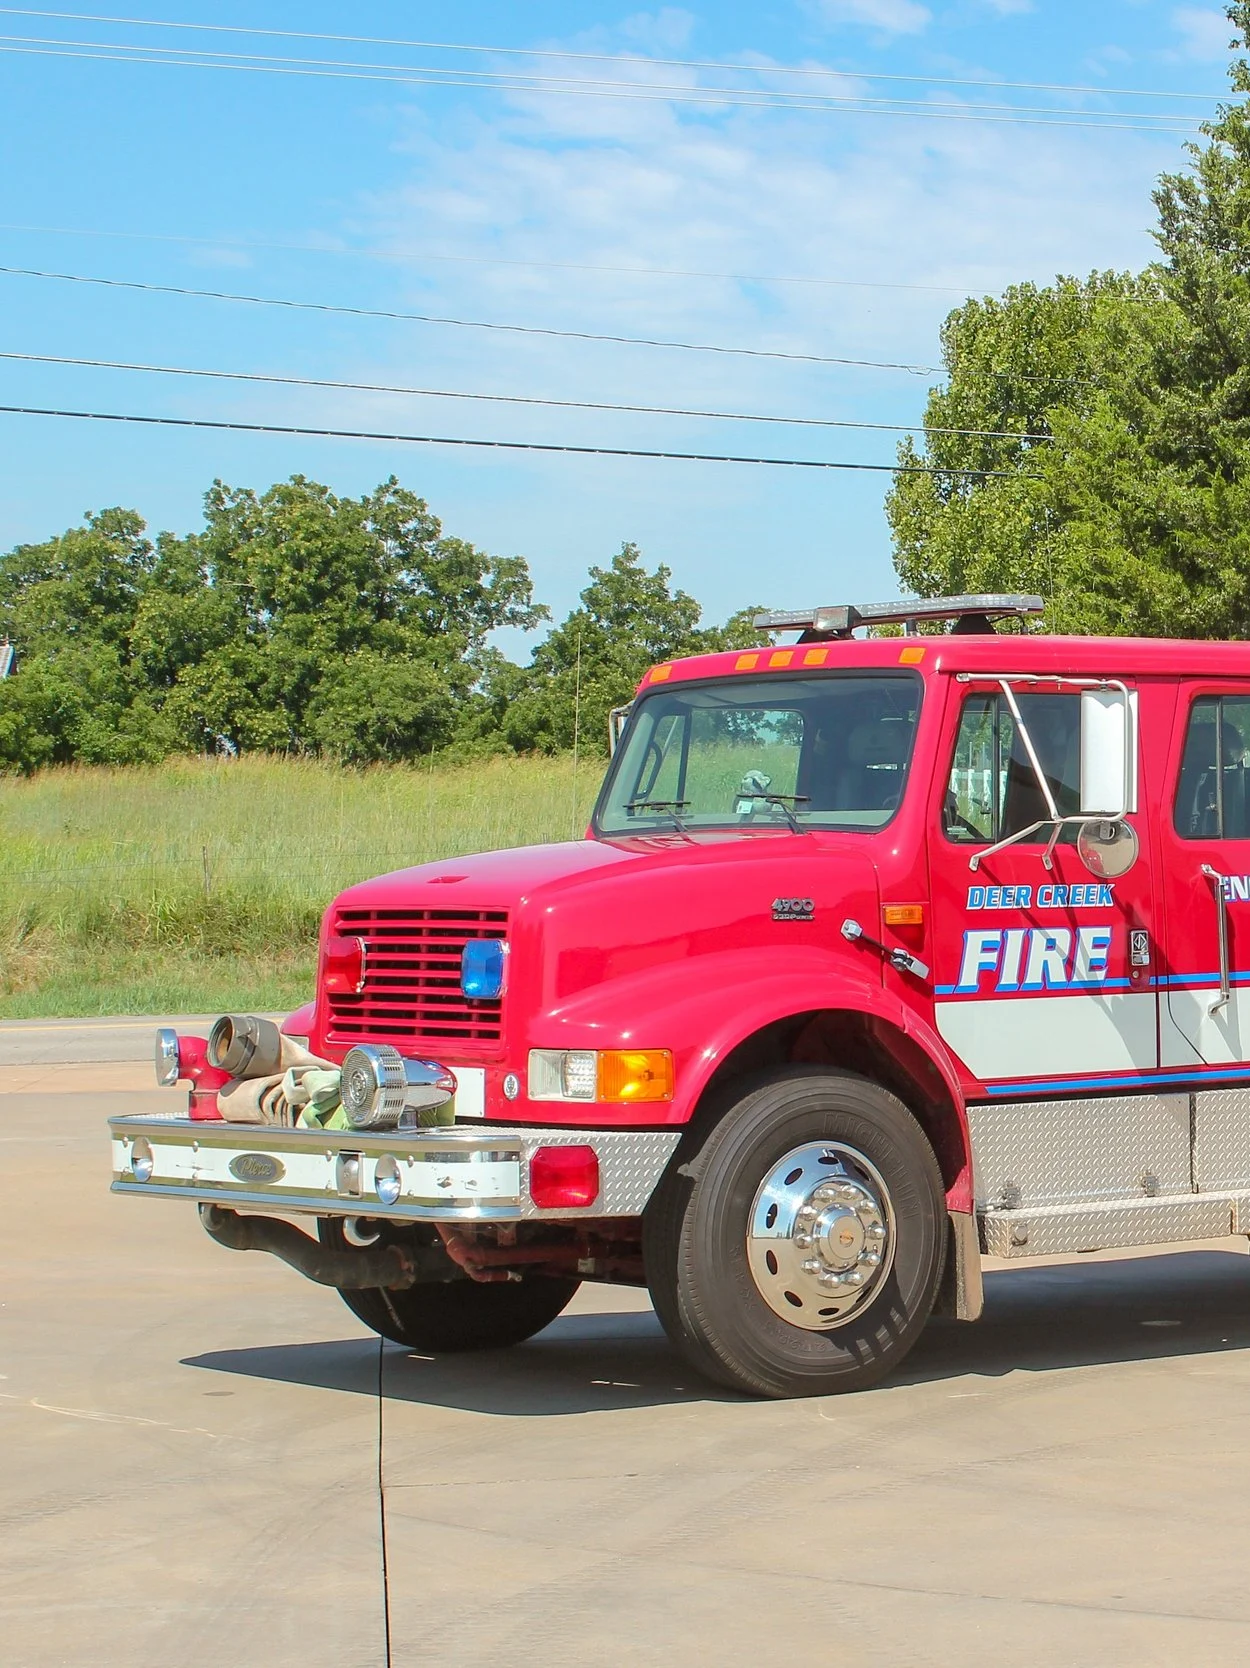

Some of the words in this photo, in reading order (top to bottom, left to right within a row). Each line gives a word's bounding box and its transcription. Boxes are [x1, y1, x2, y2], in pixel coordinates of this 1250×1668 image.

[771, 897, 815, 912] 4900
[965, 884, 1032, 910] DEER
[1036, 883, 1116, 909] CREEK
[953, 925, 1113, 995] FIRE
